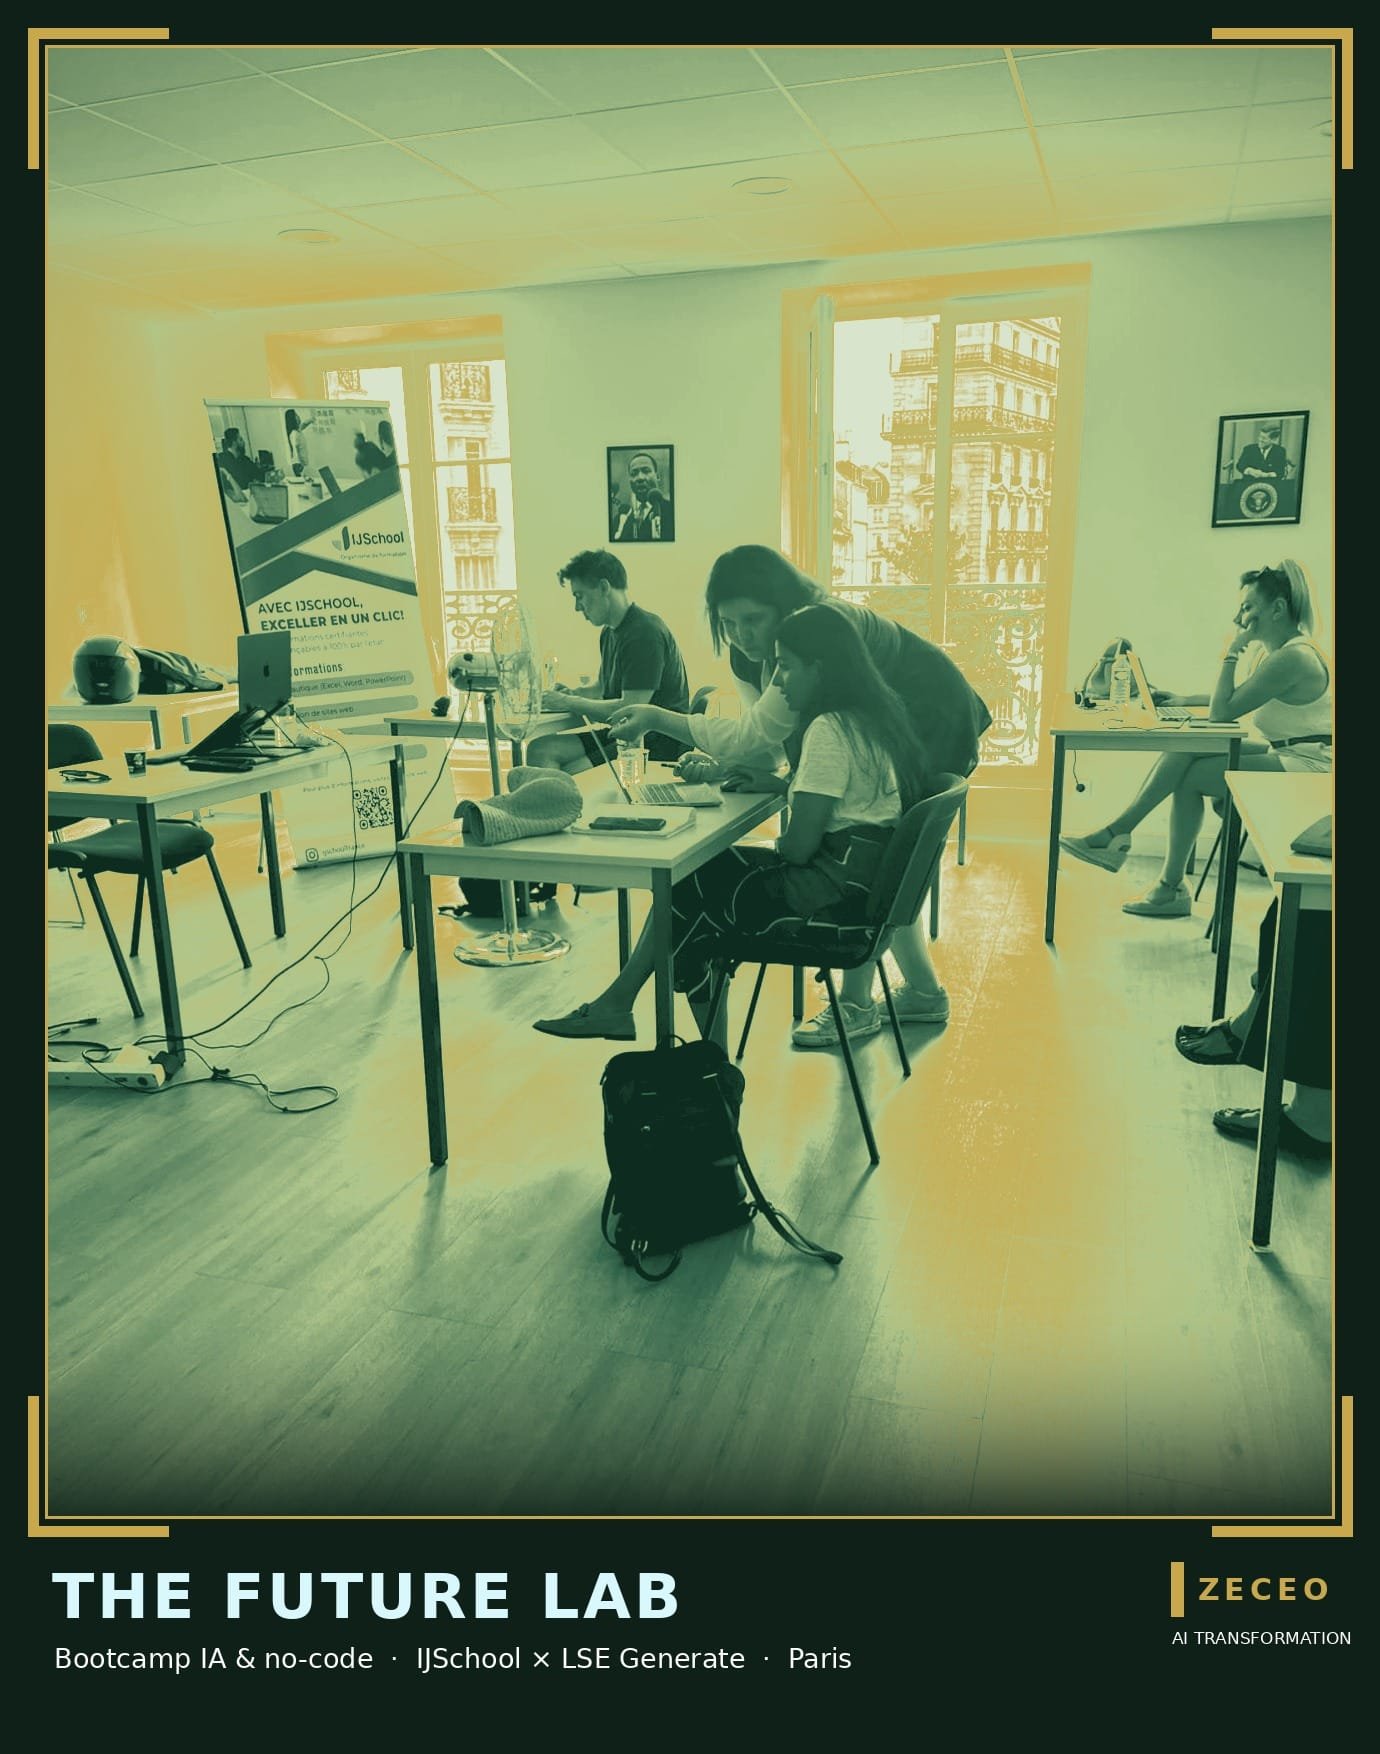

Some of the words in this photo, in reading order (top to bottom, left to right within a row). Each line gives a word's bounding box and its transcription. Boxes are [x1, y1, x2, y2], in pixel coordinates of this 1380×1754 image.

[352, 530, 405, 546] IJSchool
[258, 601, 293, 614] AVEC
[296, 596, 363, 612] IJSCHOOL,
[260, 616, 327, 631] EXCELLER
[331, 614, 348, 626] EN
[351, 613, 370, 624] UN
[373, 610, 405, 622] CLIC!
[293, 663, 344, 676] ormations
